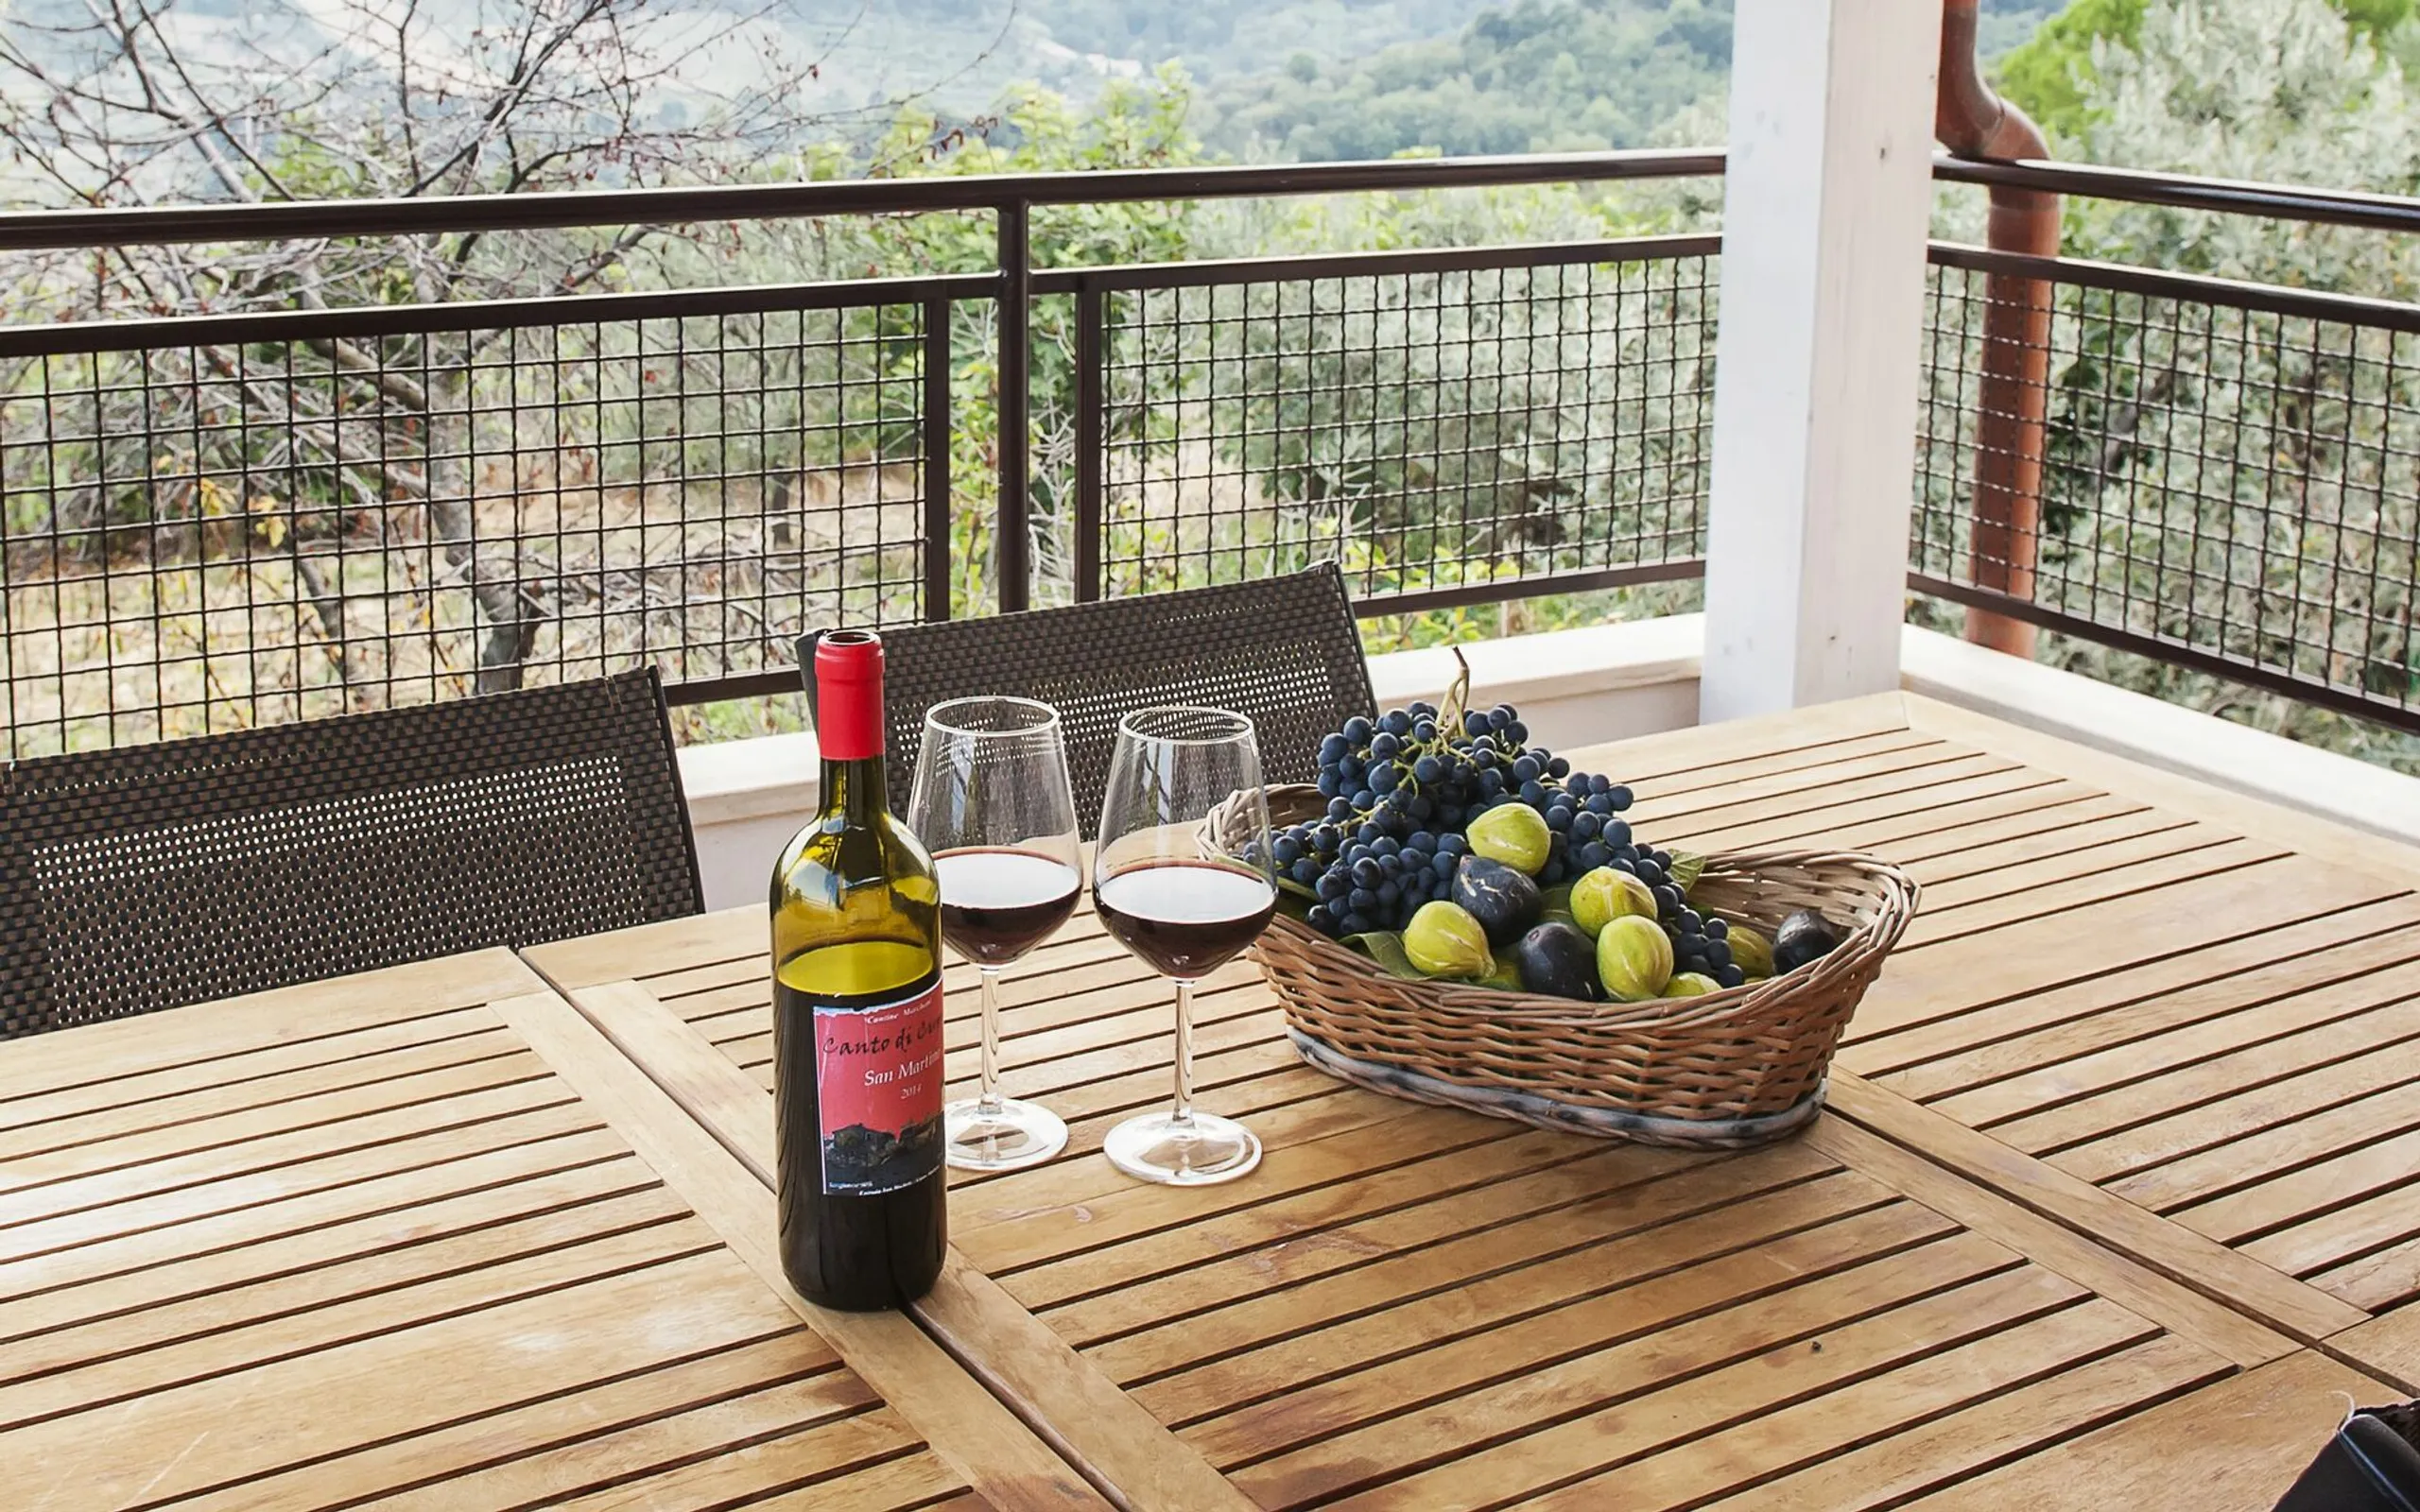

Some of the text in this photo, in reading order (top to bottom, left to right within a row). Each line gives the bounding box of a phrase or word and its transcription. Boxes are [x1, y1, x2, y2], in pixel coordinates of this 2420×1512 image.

[823, 1036, 890, 1056] Canto
[895, 1026, 912, 1053] di
[864, 1069, 893, 1086] San
[900, 1083, 922, 1099] 2014
